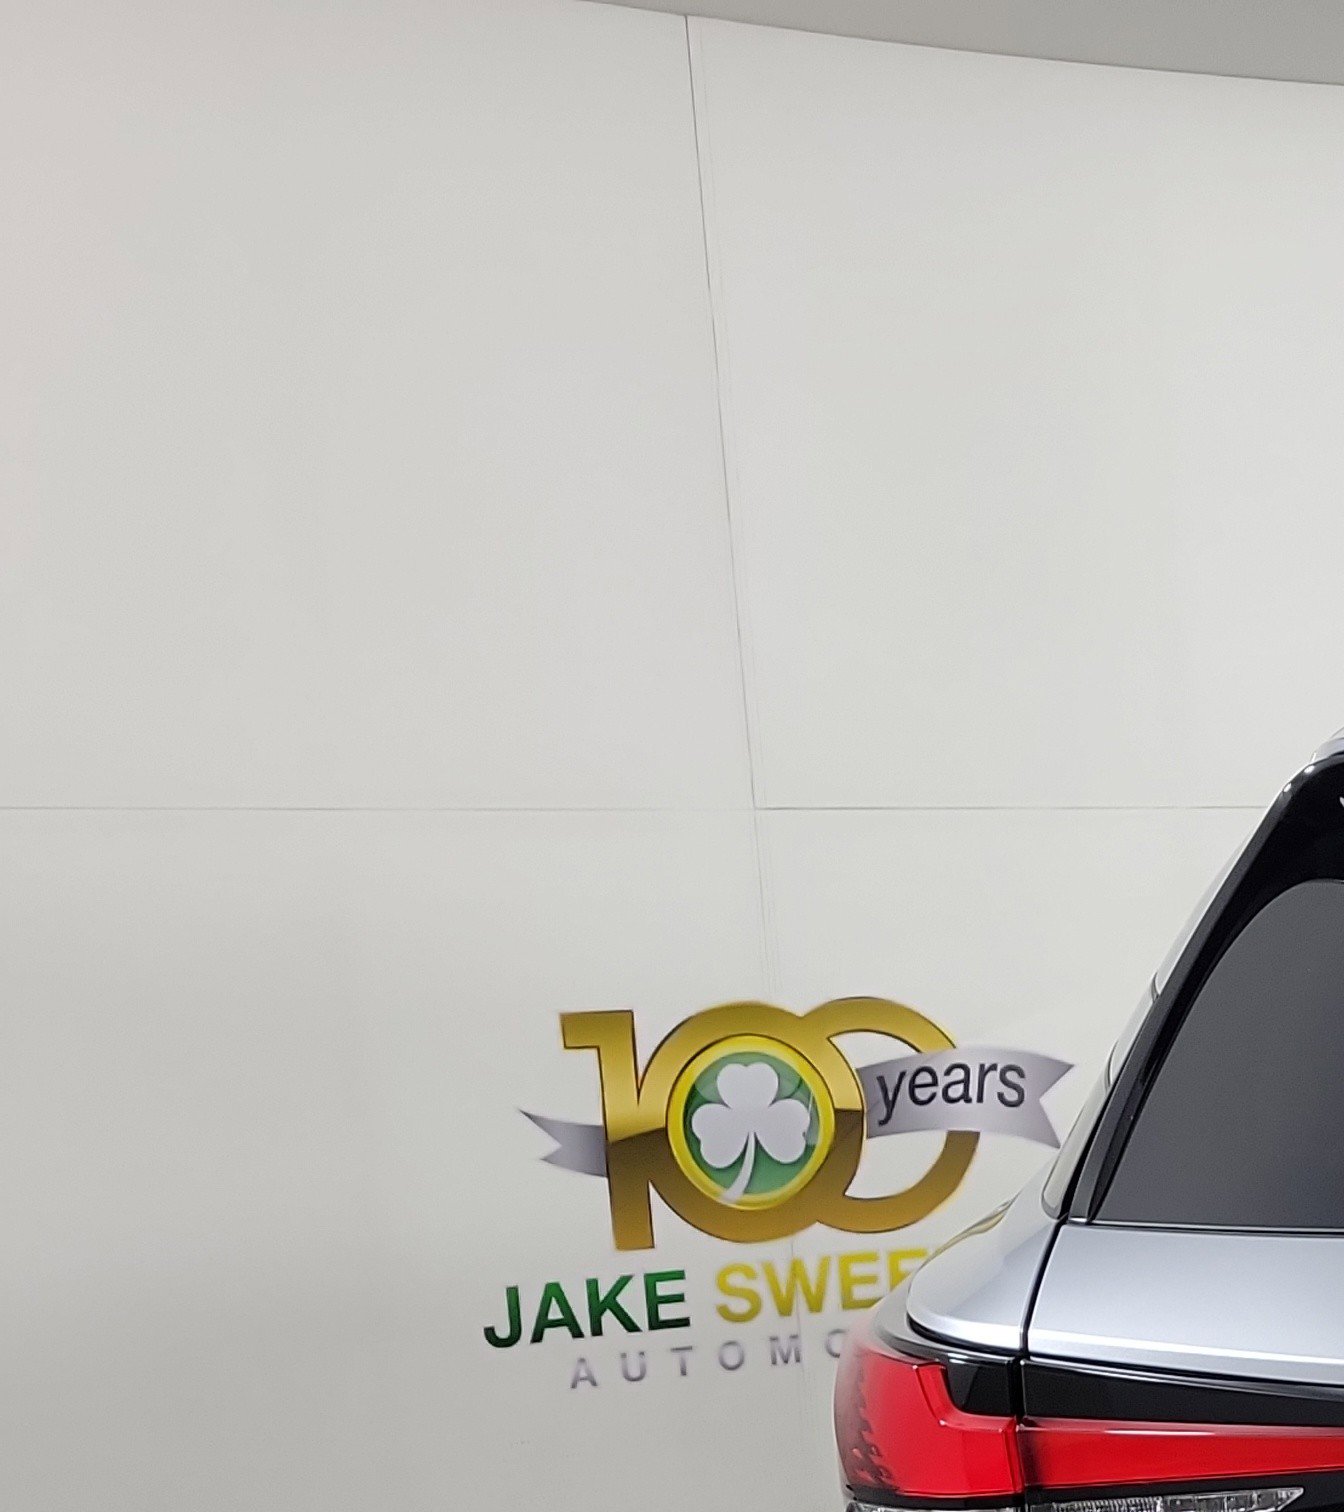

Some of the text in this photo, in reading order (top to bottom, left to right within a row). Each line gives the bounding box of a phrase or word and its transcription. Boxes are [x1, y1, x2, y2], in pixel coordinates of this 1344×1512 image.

[559, 996, 1027, 1252] 100 years
[483, 1248, 928, 1349] JAKE SWEE
